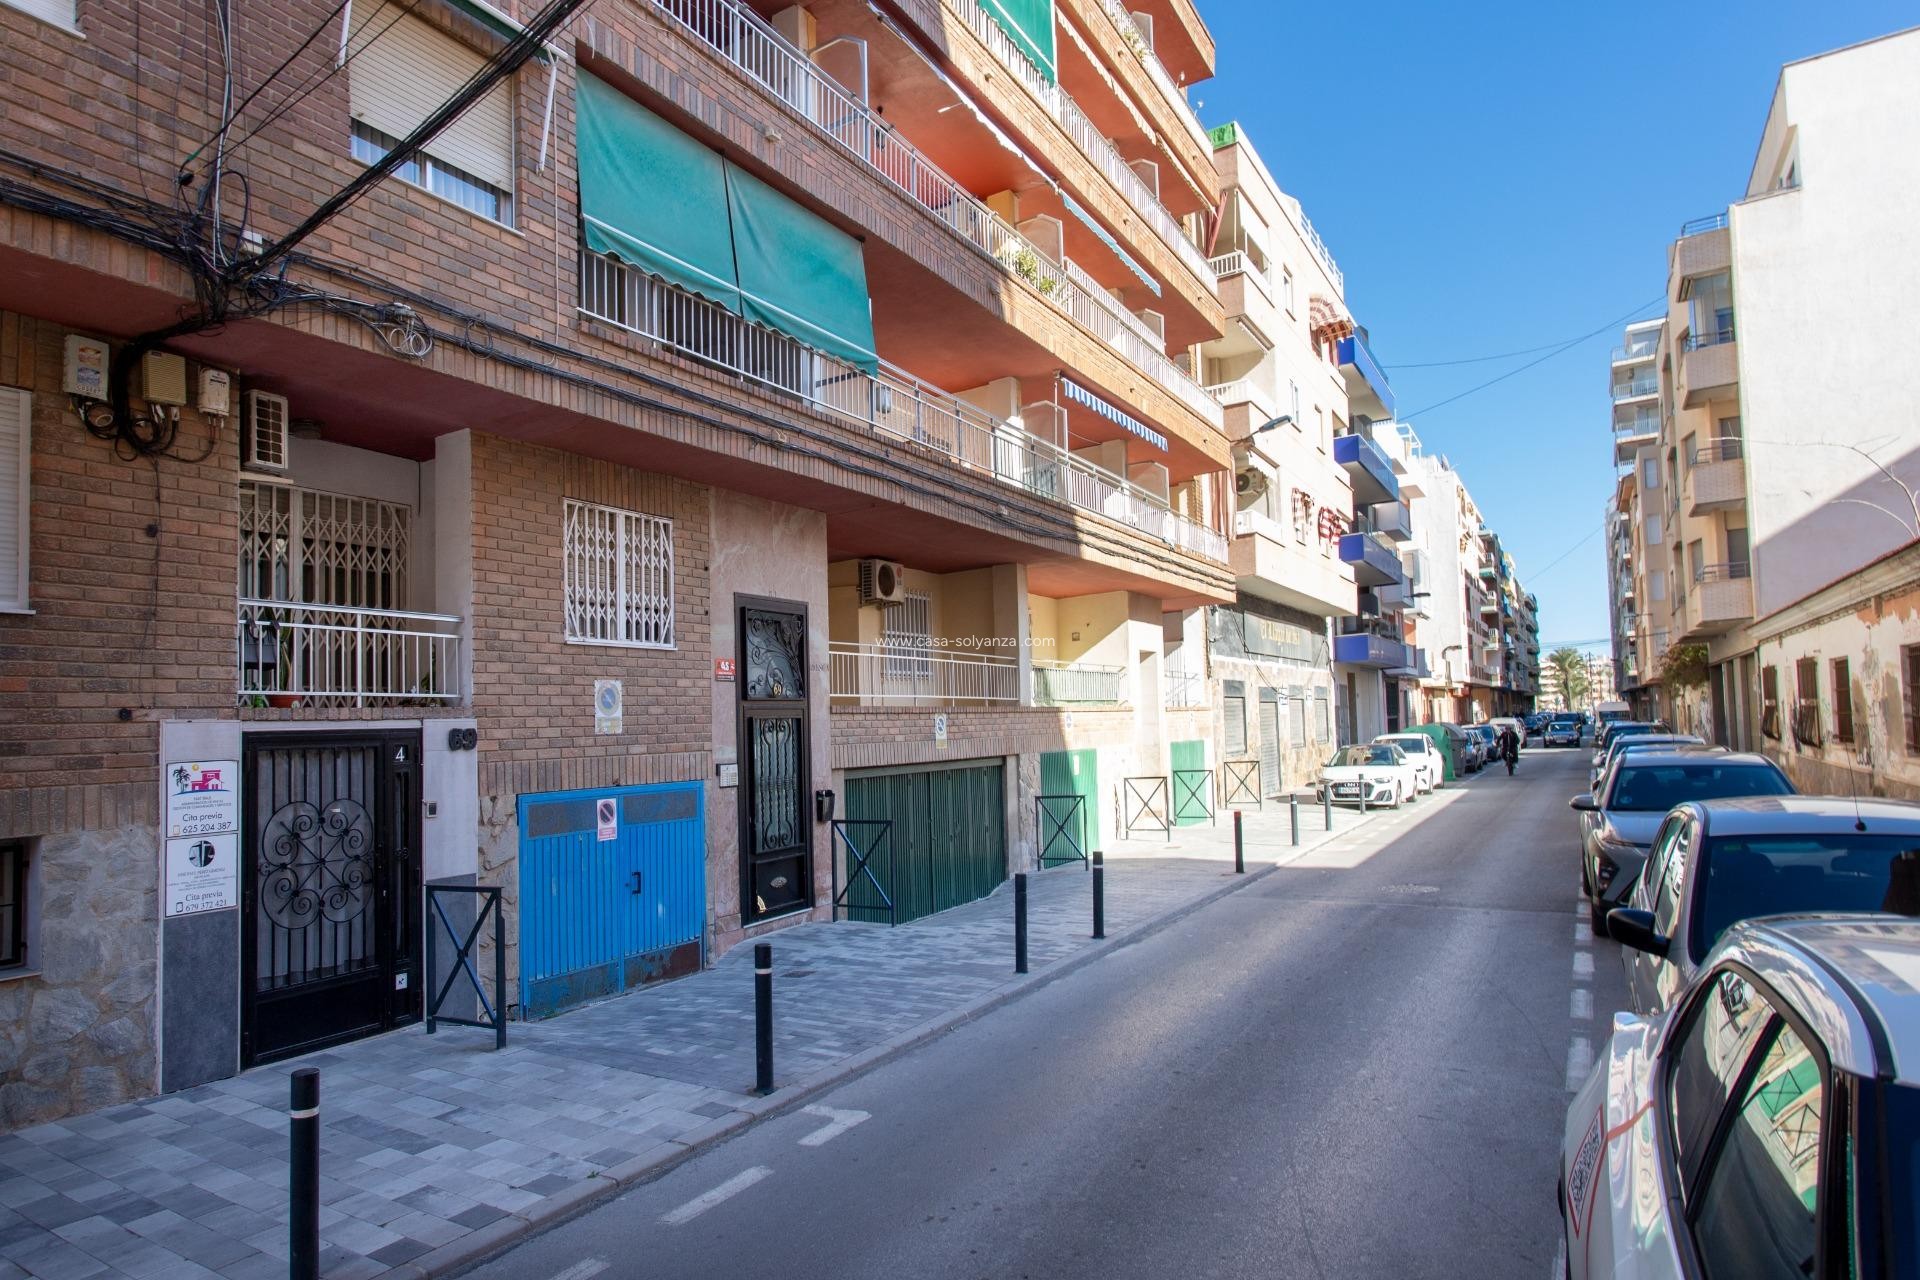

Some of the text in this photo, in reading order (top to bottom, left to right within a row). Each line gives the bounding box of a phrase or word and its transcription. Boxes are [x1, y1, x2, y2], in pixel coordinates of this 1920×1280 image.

[449, 728, 477, 751] 69
[395, 747, 405, 762] 4
[182, 812, 223, 822] Cita previa
[182, 822, 232, 833] 625 204 387
[202, 890, 223, 900] previa
[200, 902, 214, 910] 372
[215, 899, 227, 907] 421
